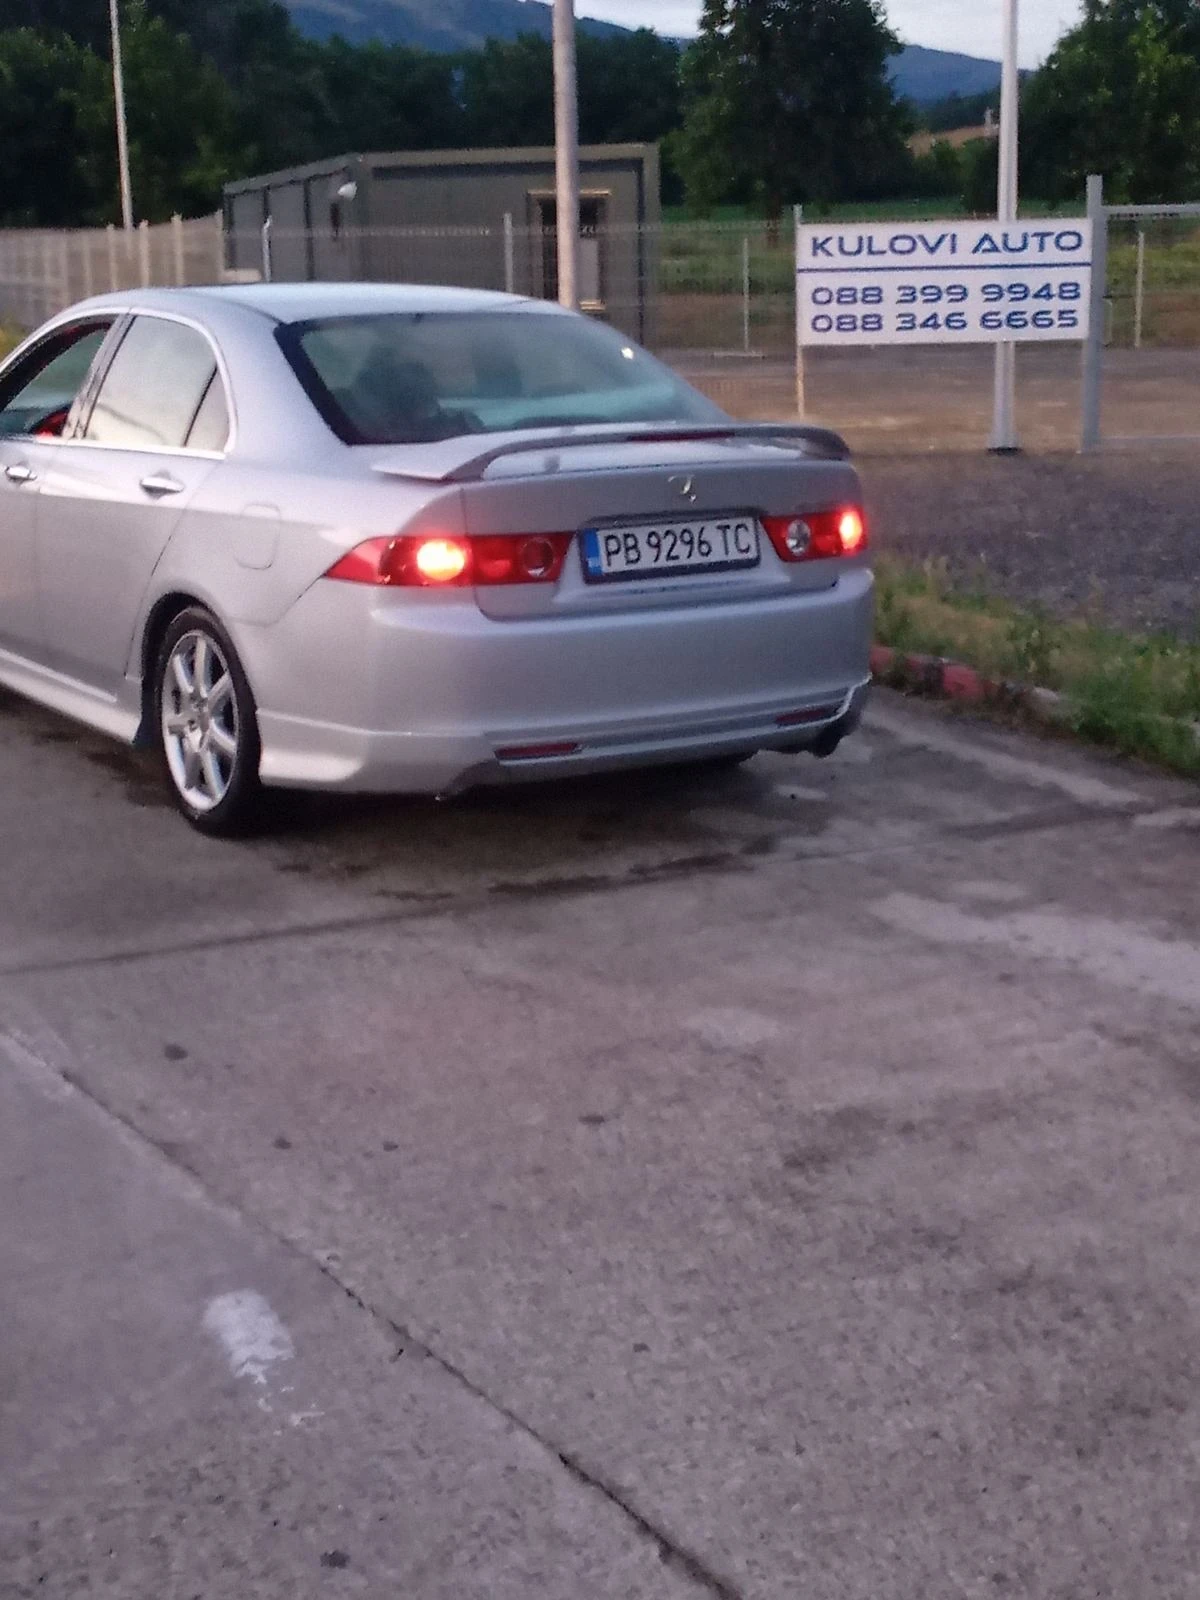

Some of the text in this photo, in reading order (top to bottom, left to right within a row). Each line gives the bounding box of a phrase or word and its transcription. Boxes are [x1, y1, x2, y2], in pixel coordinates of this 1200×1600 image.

[811, 231, 1082, 257] KULOVI AUTO
[811, 282, 1081, 306] 088 399 9948
[811, 309, 1079, 333] 088 346 6665
[604, 523, 750, 567] PB 9296 TC
